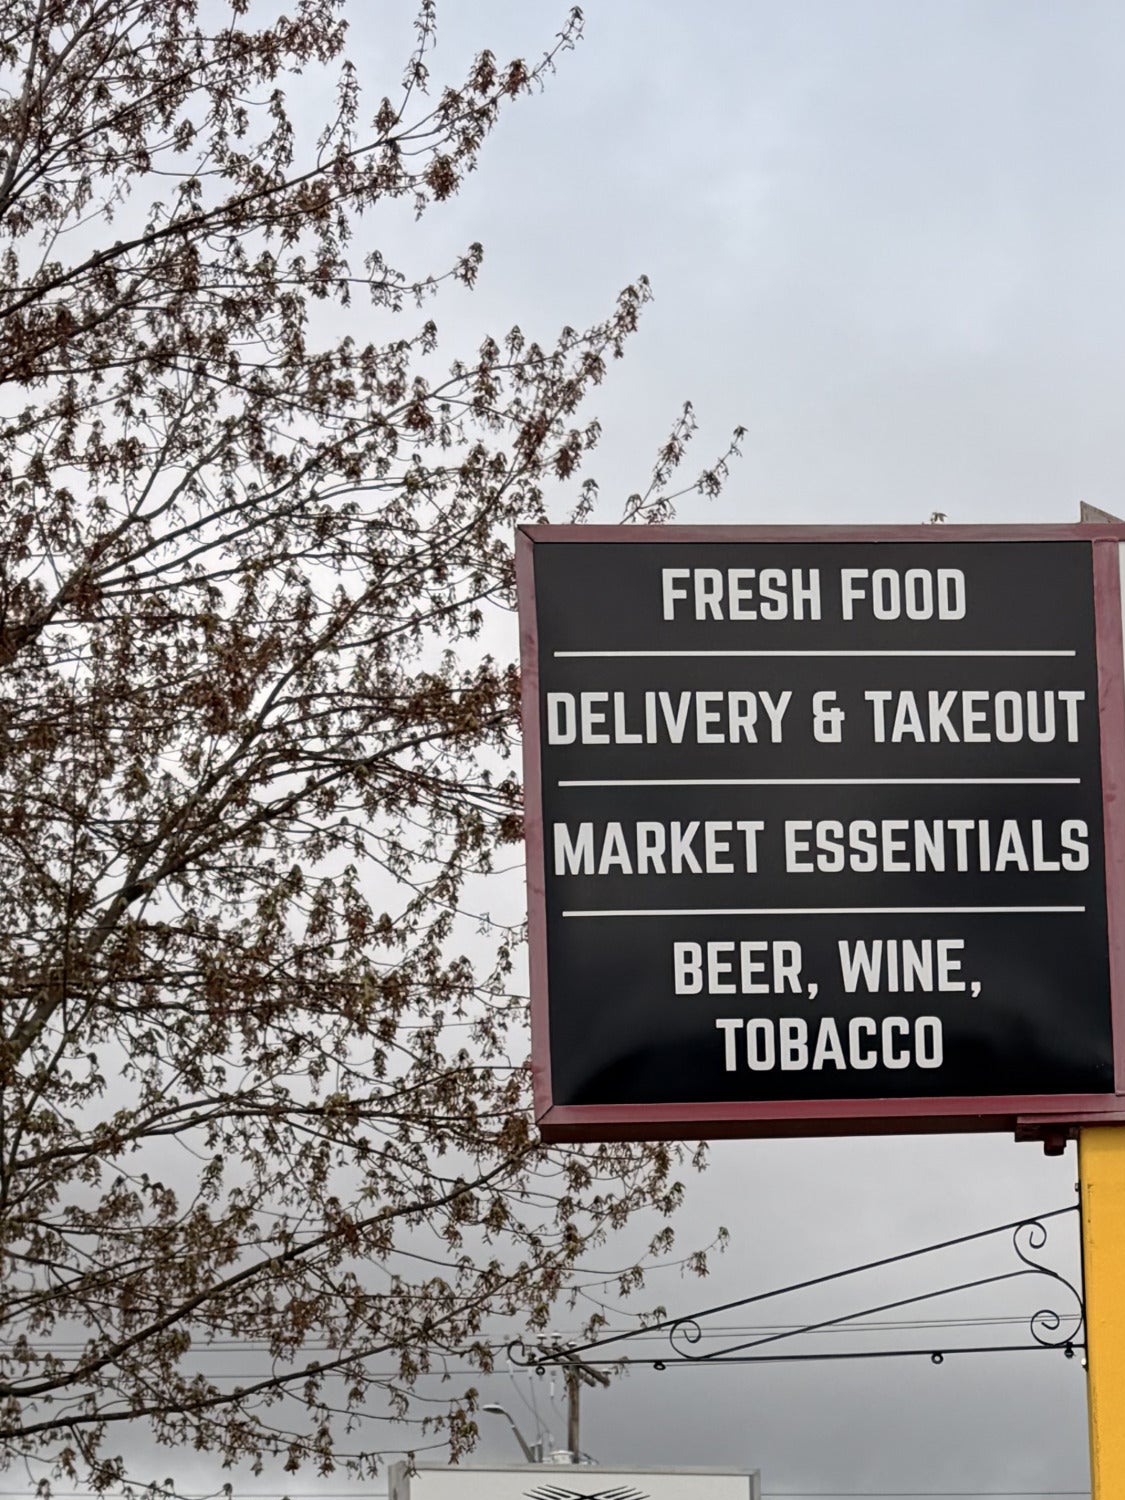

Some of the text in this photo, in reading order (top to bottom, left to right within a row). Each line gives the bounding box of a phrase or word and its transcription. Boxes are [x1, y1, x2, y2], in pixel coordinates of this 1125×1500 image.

[661, 567, 967, 622] FRESH FOOD
[547, 690, 1086, 745] DELIVERY & TAKEOUT
[553, 819, 1090, 876] MARKET ESSENTIALS
[673, 938, 982, 1000] BEER, WINE,
[715, 1016, 944, 1072] TOBACCO
